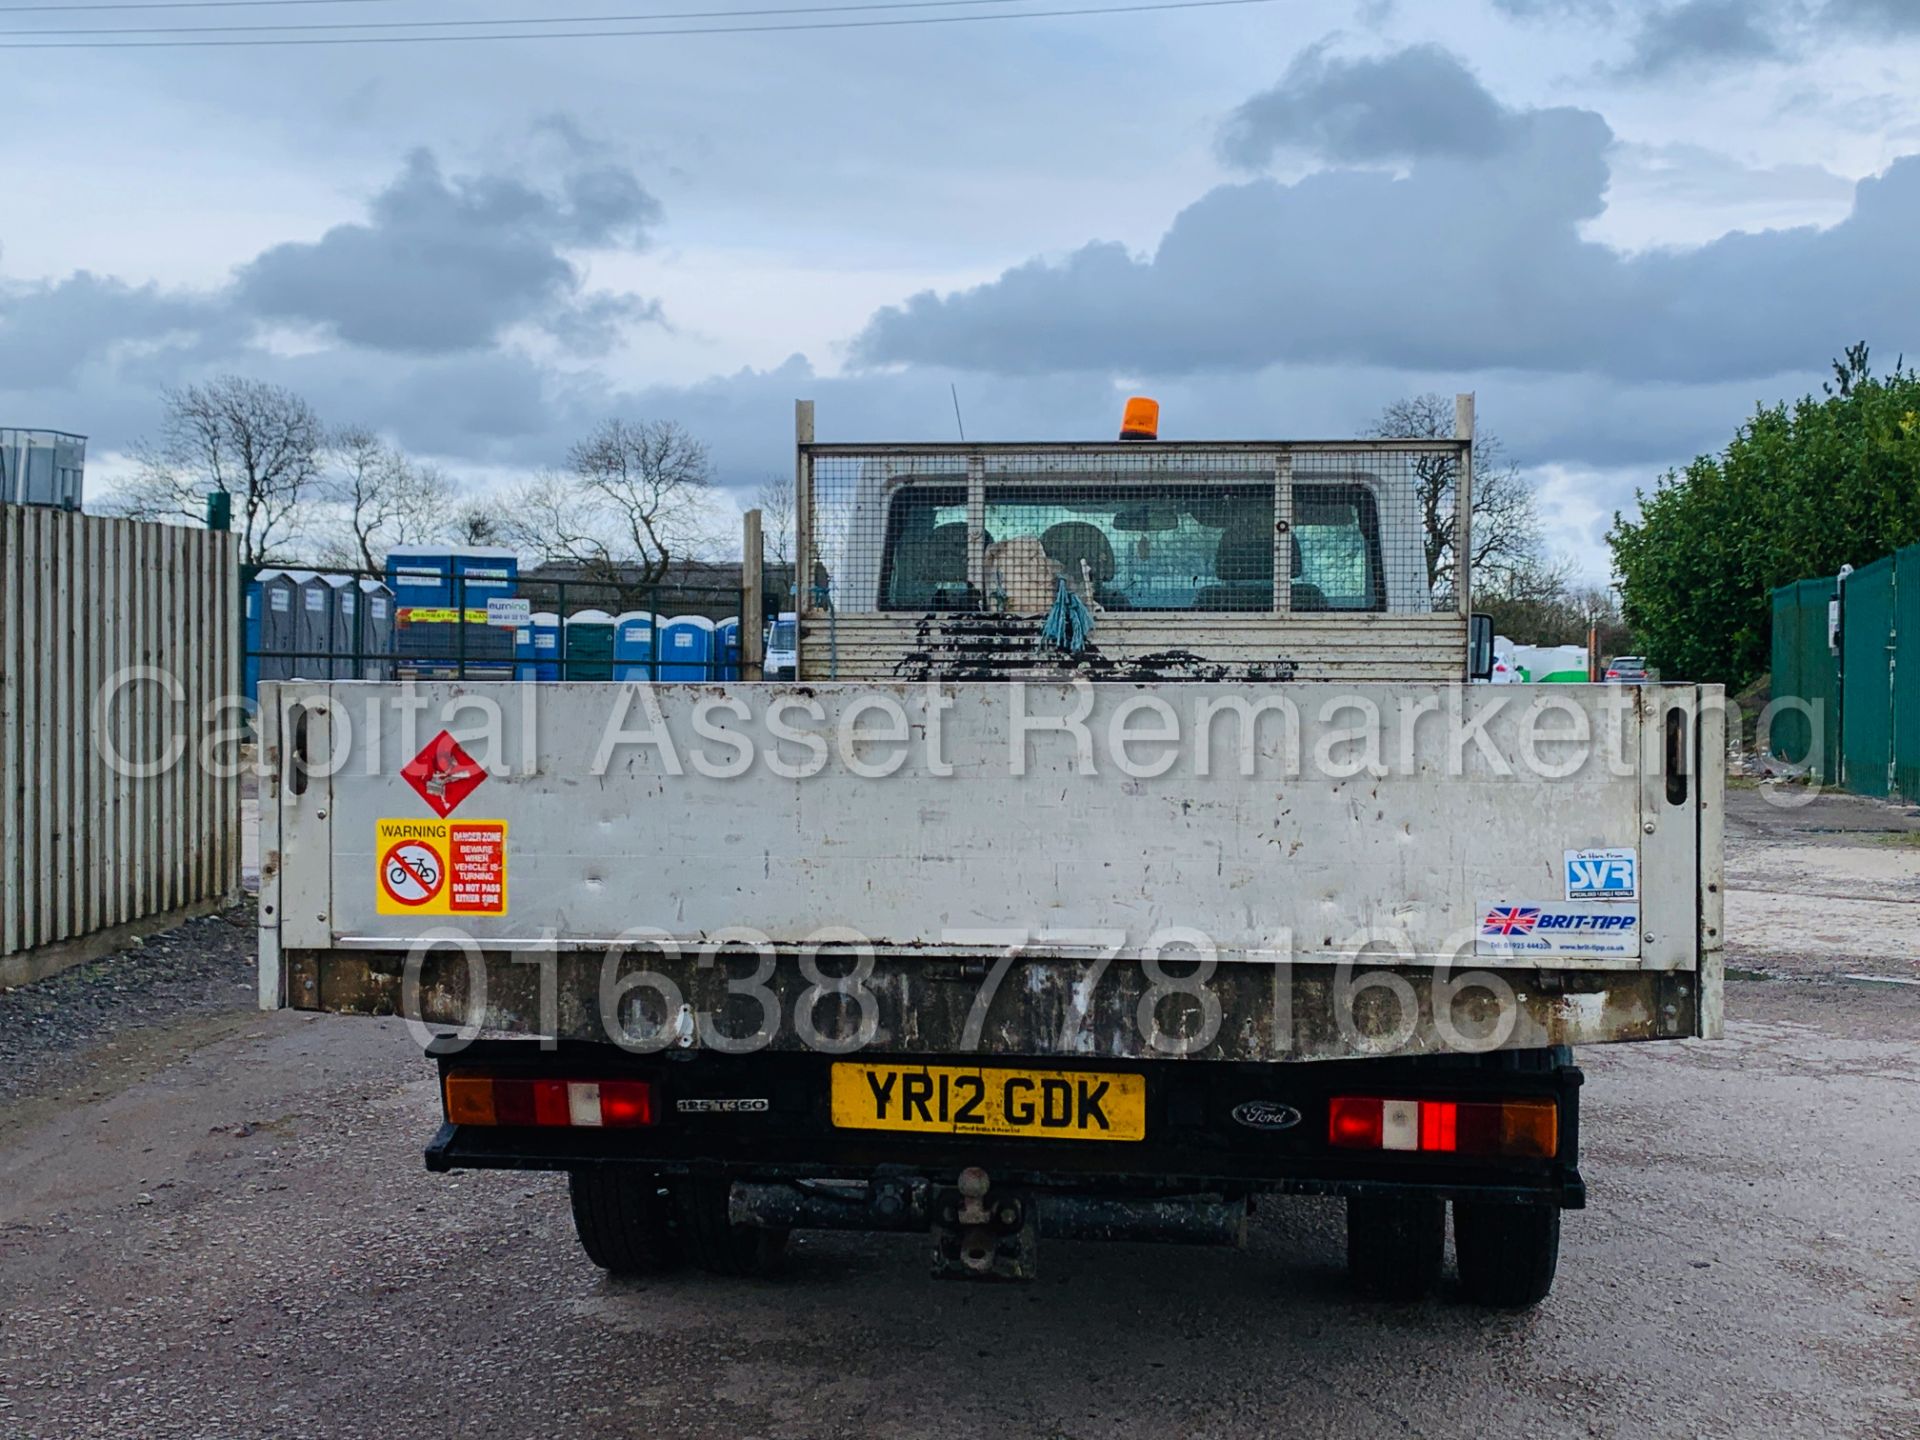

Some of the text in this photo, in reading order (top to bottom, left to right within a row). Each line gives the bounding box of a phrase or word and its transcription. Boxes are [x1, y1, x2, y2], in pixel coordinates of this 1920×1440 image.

[381, 825, 447, 838] WARNING
[453, 832, 501, 842] DANGER ZONE
[460, 845, 493, 854] BEWARE
[464, 854, 489, 862] WHEN
[454, 863, 499, 871] VEHICLE IS
[459, 872, 494, 880] TURNING
[1570, 861, 1632, 889] SVR
[453, 883, 501, 893] DO NOT PASS
[1537, 914, 1636, 930] BRIT-TIPP
[1559, 944, 1624, 952] www.brit-tipp.co.uk
[866, 1071, 1110, 1130] YR12 GDK
[1243, 1105, 1286, 1123] Ford
